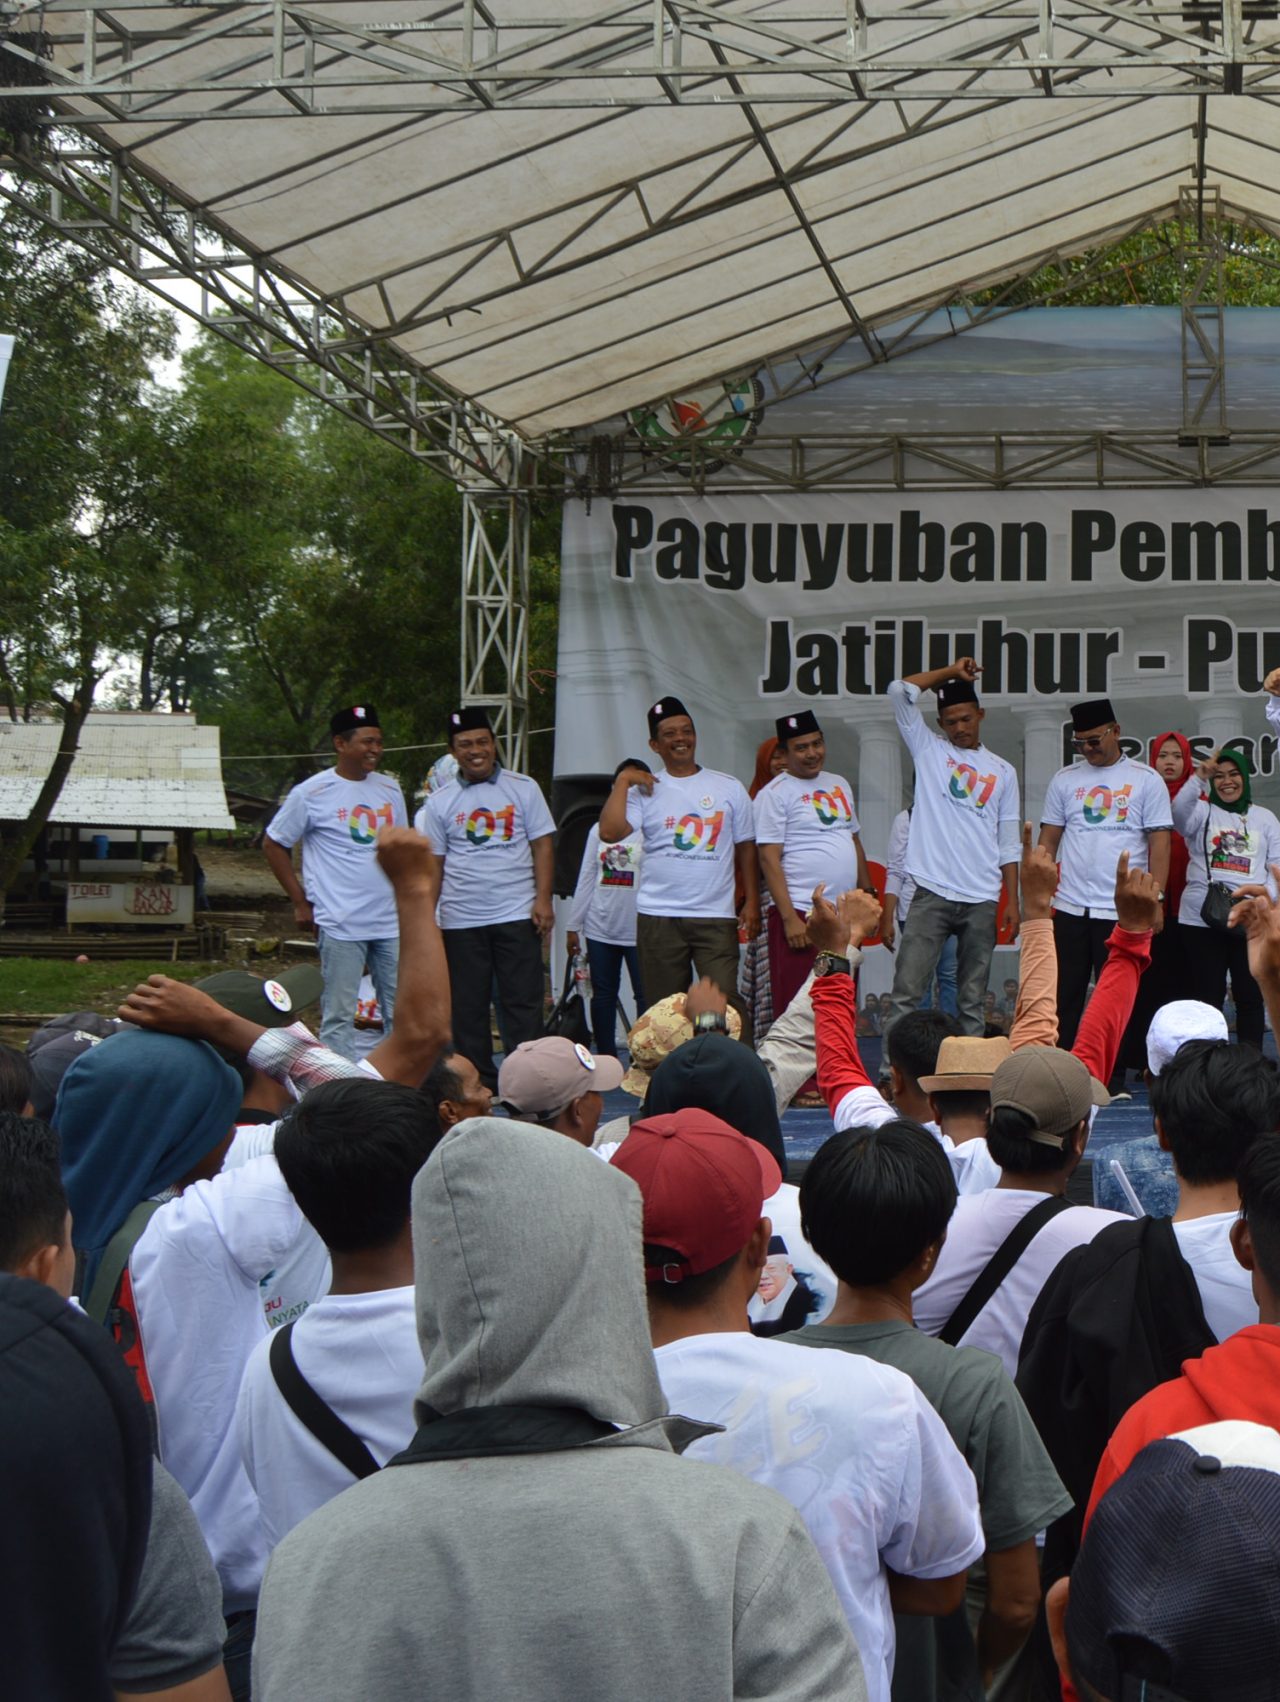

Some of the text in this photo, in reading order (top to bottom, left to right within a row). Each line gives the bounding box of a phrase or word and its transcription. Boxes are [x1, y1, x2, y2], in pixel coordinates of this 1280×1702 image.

[613, 503, 1047, 591] Paguyuban
[762, 619, 1119, 696] Jatiluhur
[1138, 655, 1166, 669] -
[455, 805, 515, 846] #01
[801, 786, 852, 826] #01
[664, 811, 724, 852] #01
[70, 884, 111, 896] TOILET
